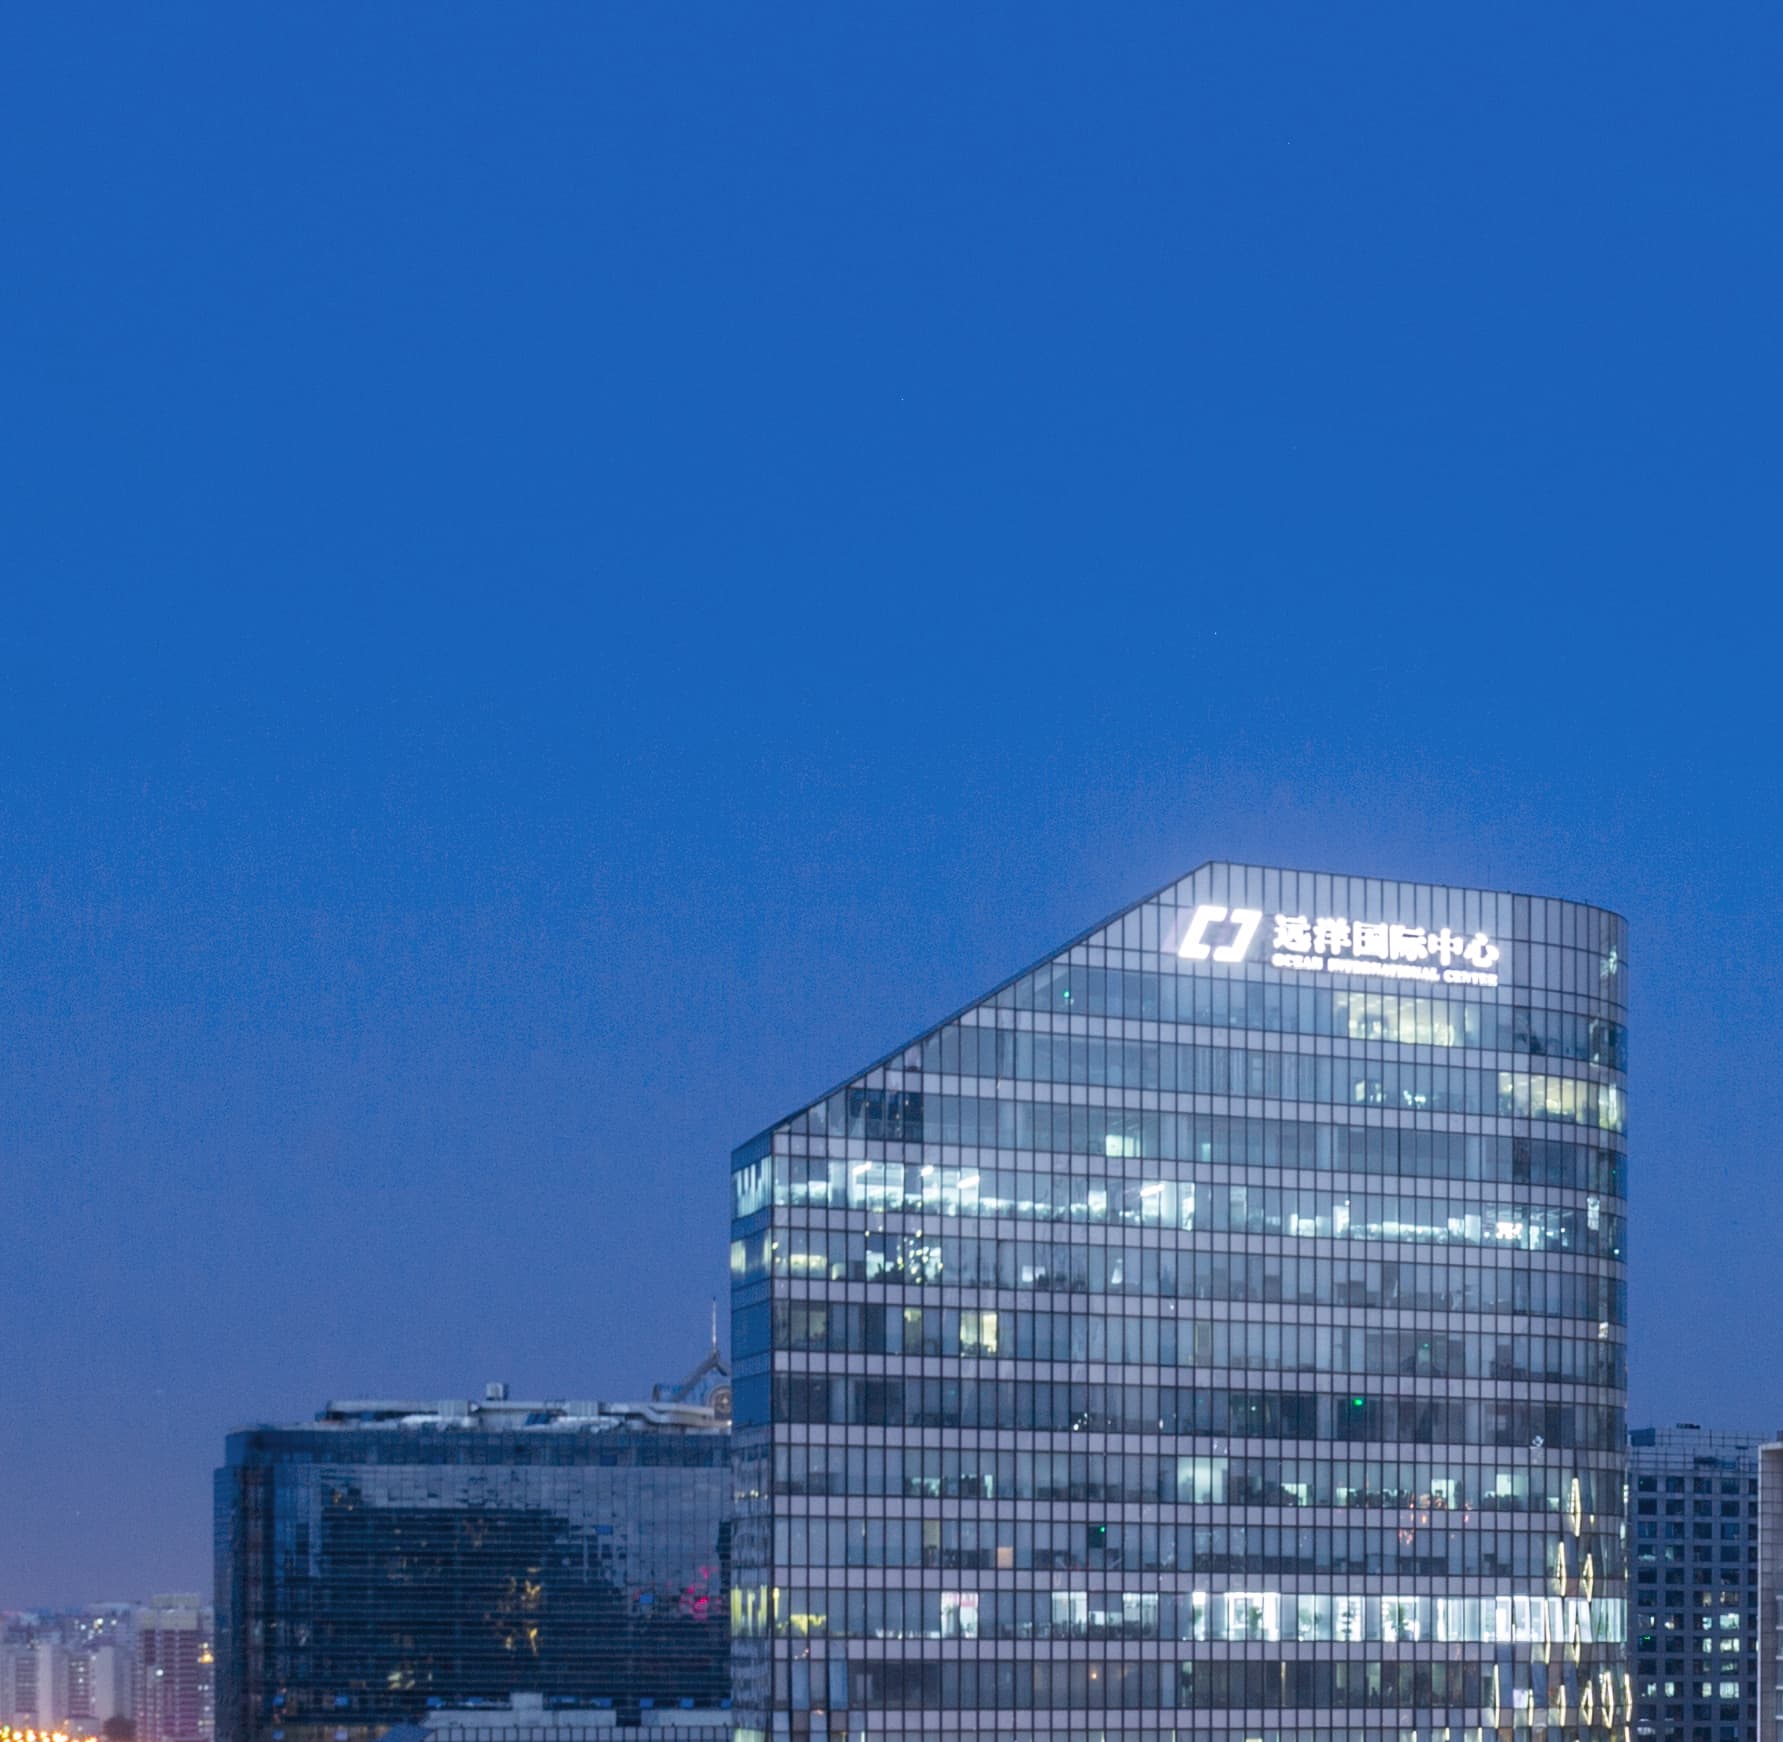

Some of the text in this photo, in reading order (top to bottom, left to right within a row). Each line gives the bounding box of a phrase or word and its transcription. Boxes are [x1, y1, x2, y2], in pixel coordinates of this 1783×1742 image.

[1273, 914, 1499, 968] 远洋国际中心
